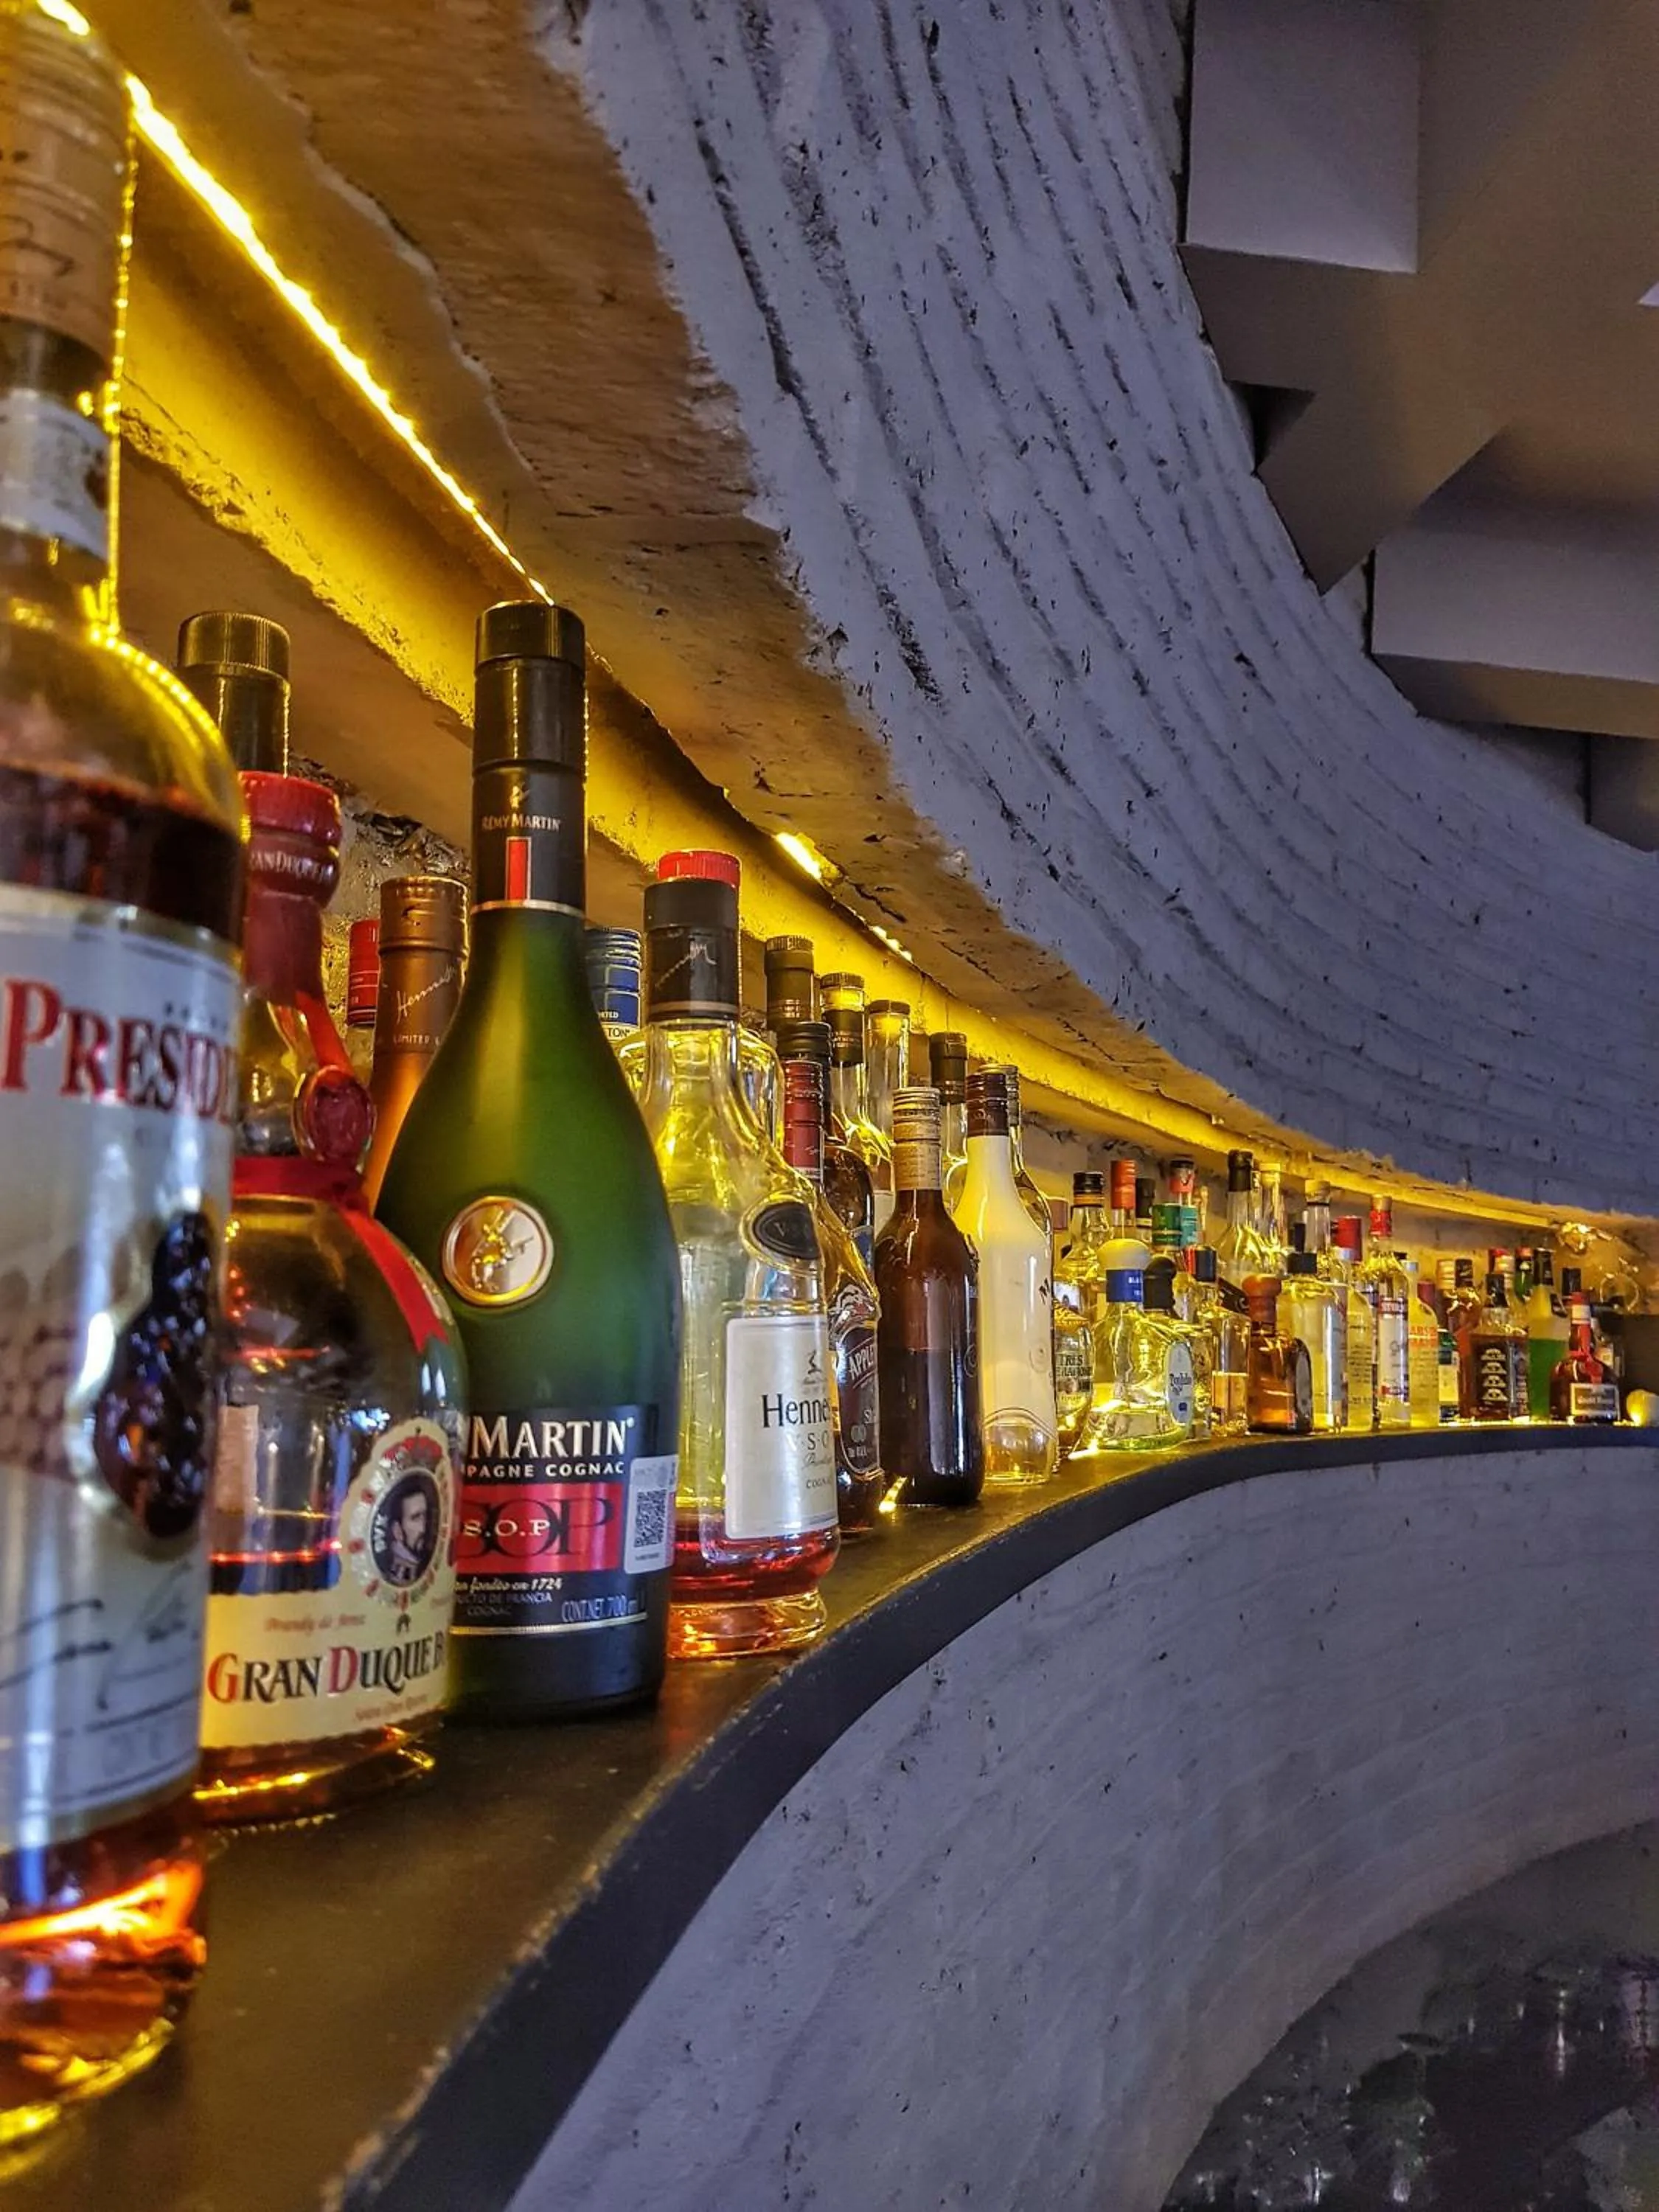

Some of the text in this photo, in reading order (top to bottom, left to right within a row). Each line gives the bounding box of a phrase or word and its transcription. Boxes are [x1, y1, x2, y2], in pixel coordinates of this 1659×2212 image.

[511, 813, 561, 831] MARTIN
[470, 1414, 627, 1459] MARTIN
[462, 1461, 625, 1478] PAGNE COGNAC
[531, 1577, 563, 1590] 1724
[207, 1652, 323, 1703] GRAN
[327, 1636, 432, 1696] DUQUE
